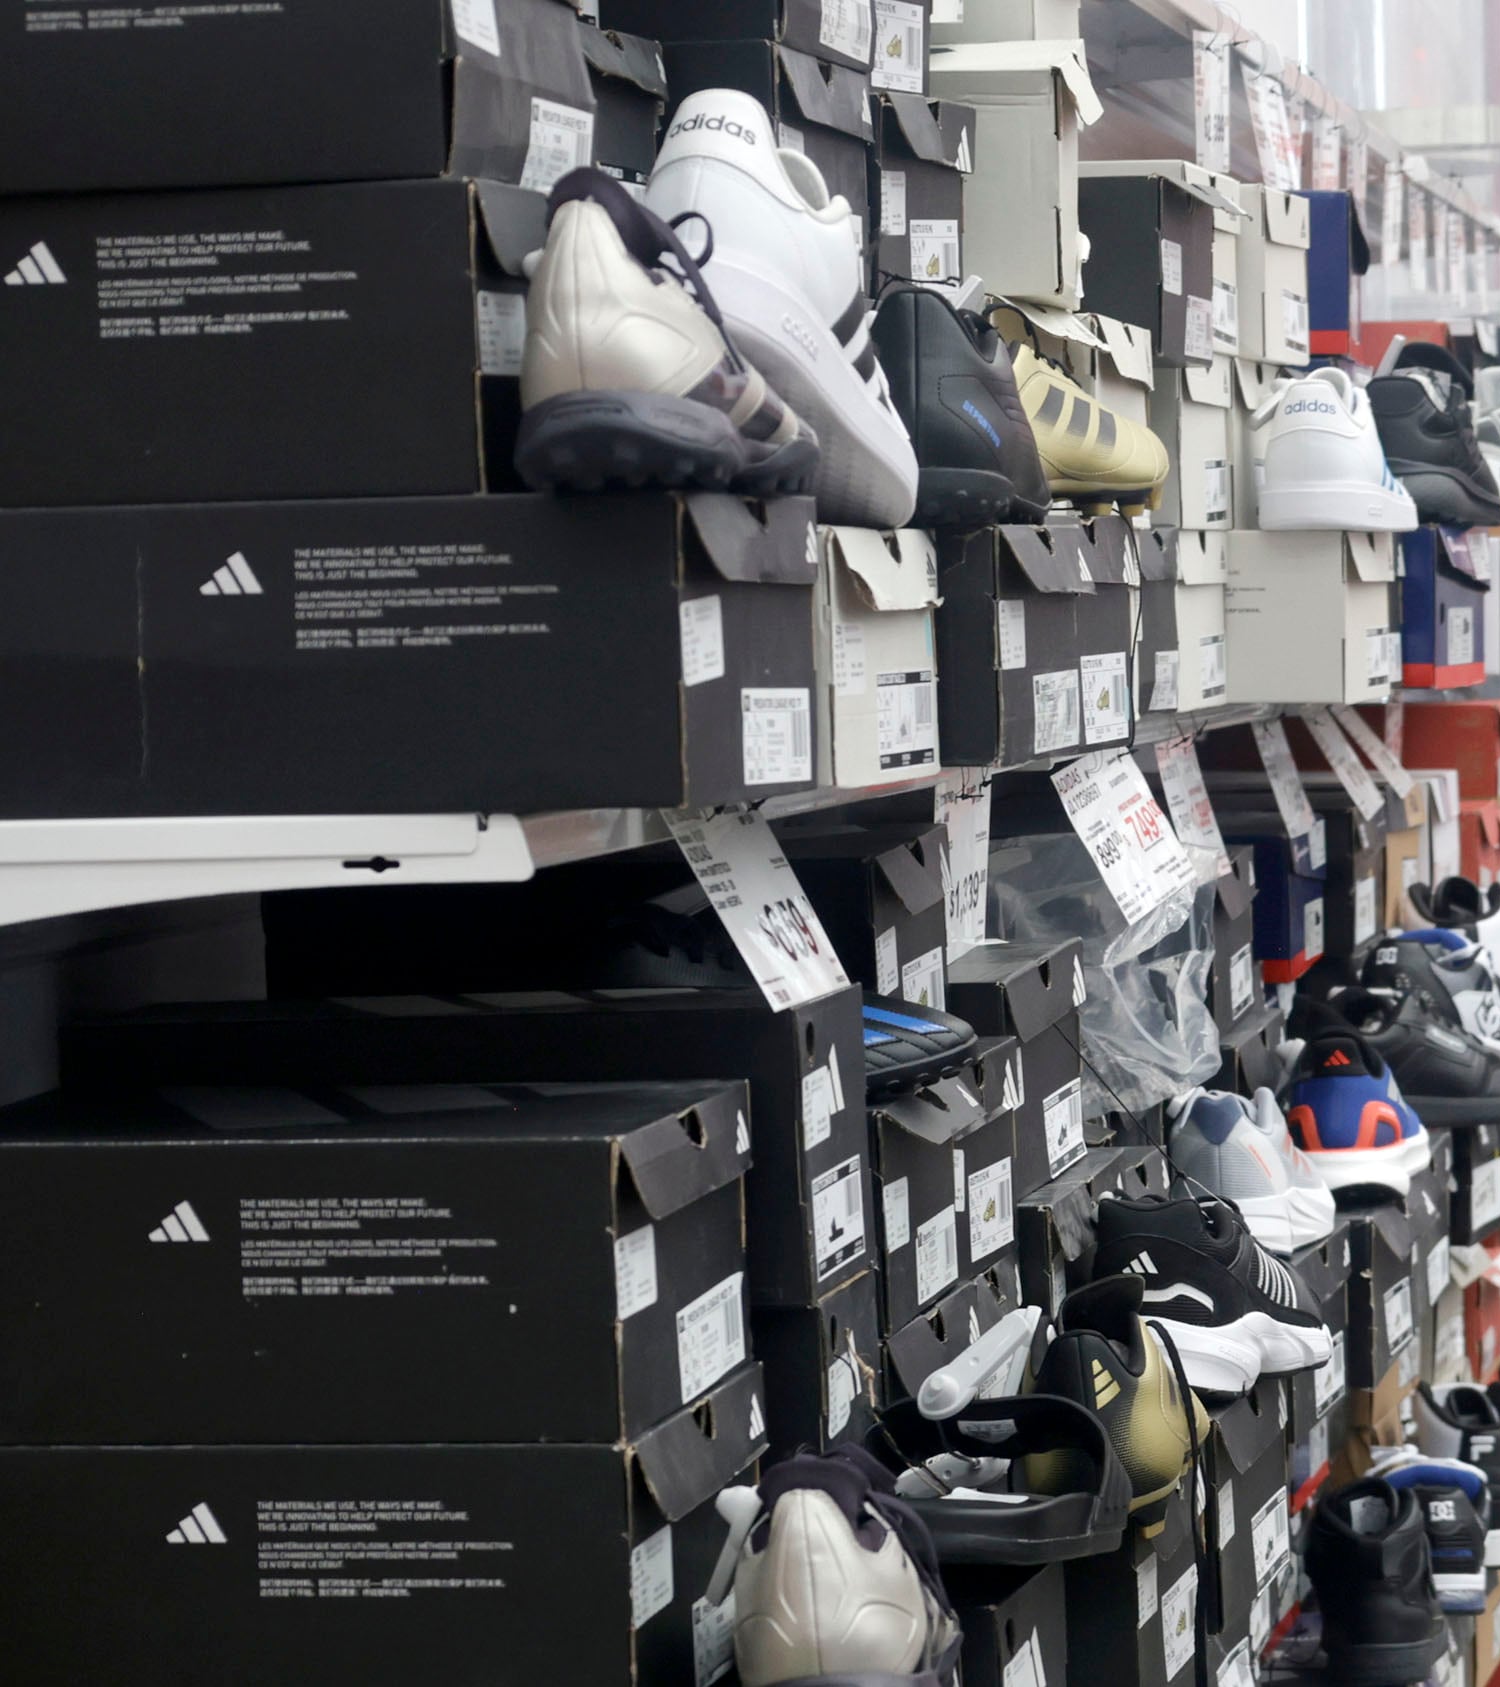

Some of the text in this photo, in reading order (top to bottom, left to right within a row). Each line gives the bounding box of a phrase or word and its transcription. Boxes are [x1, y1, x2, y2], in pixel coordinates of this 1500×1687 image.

[670, 113, 756, 145] adidas
[1284, 400, 1336, 415] adidas
[1124, 804, 1159, 849] 749
